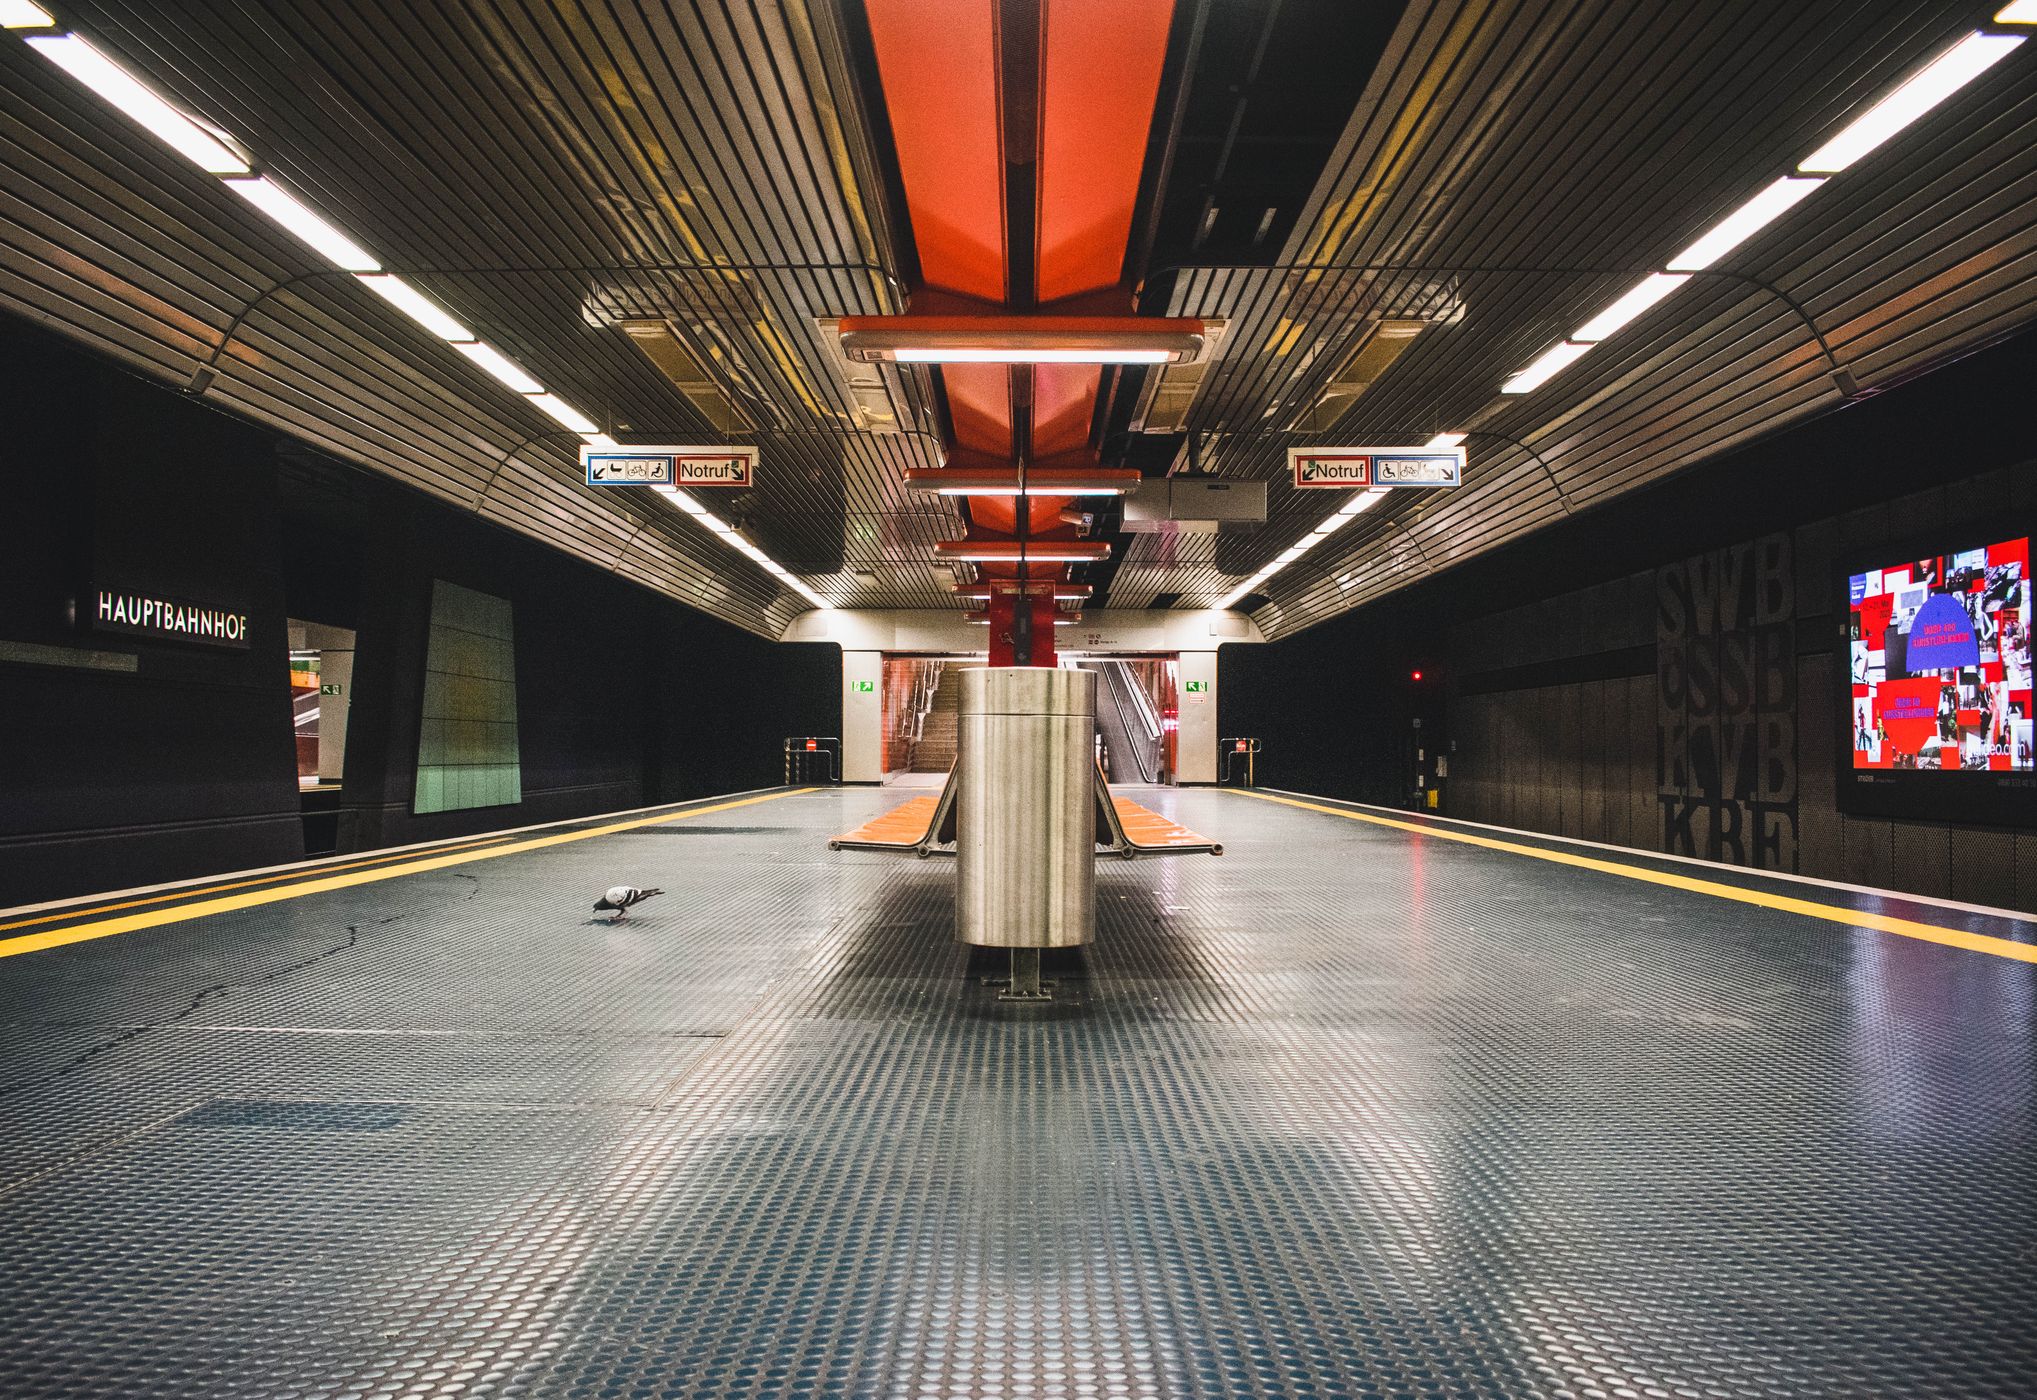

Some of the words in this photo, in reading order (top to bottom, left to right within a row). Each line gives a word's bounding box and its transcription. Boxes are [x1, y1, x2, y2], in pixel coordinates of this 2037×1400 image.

[681, 463, 729, 477] Notruf
[1316, 464, 1364, 478] Notruf
[1656, 532, 1795, 639] SWB
[99, 591, 247, 641] HAUPTBAHNHOF
[1658, 712, 1796, 803] KVB
